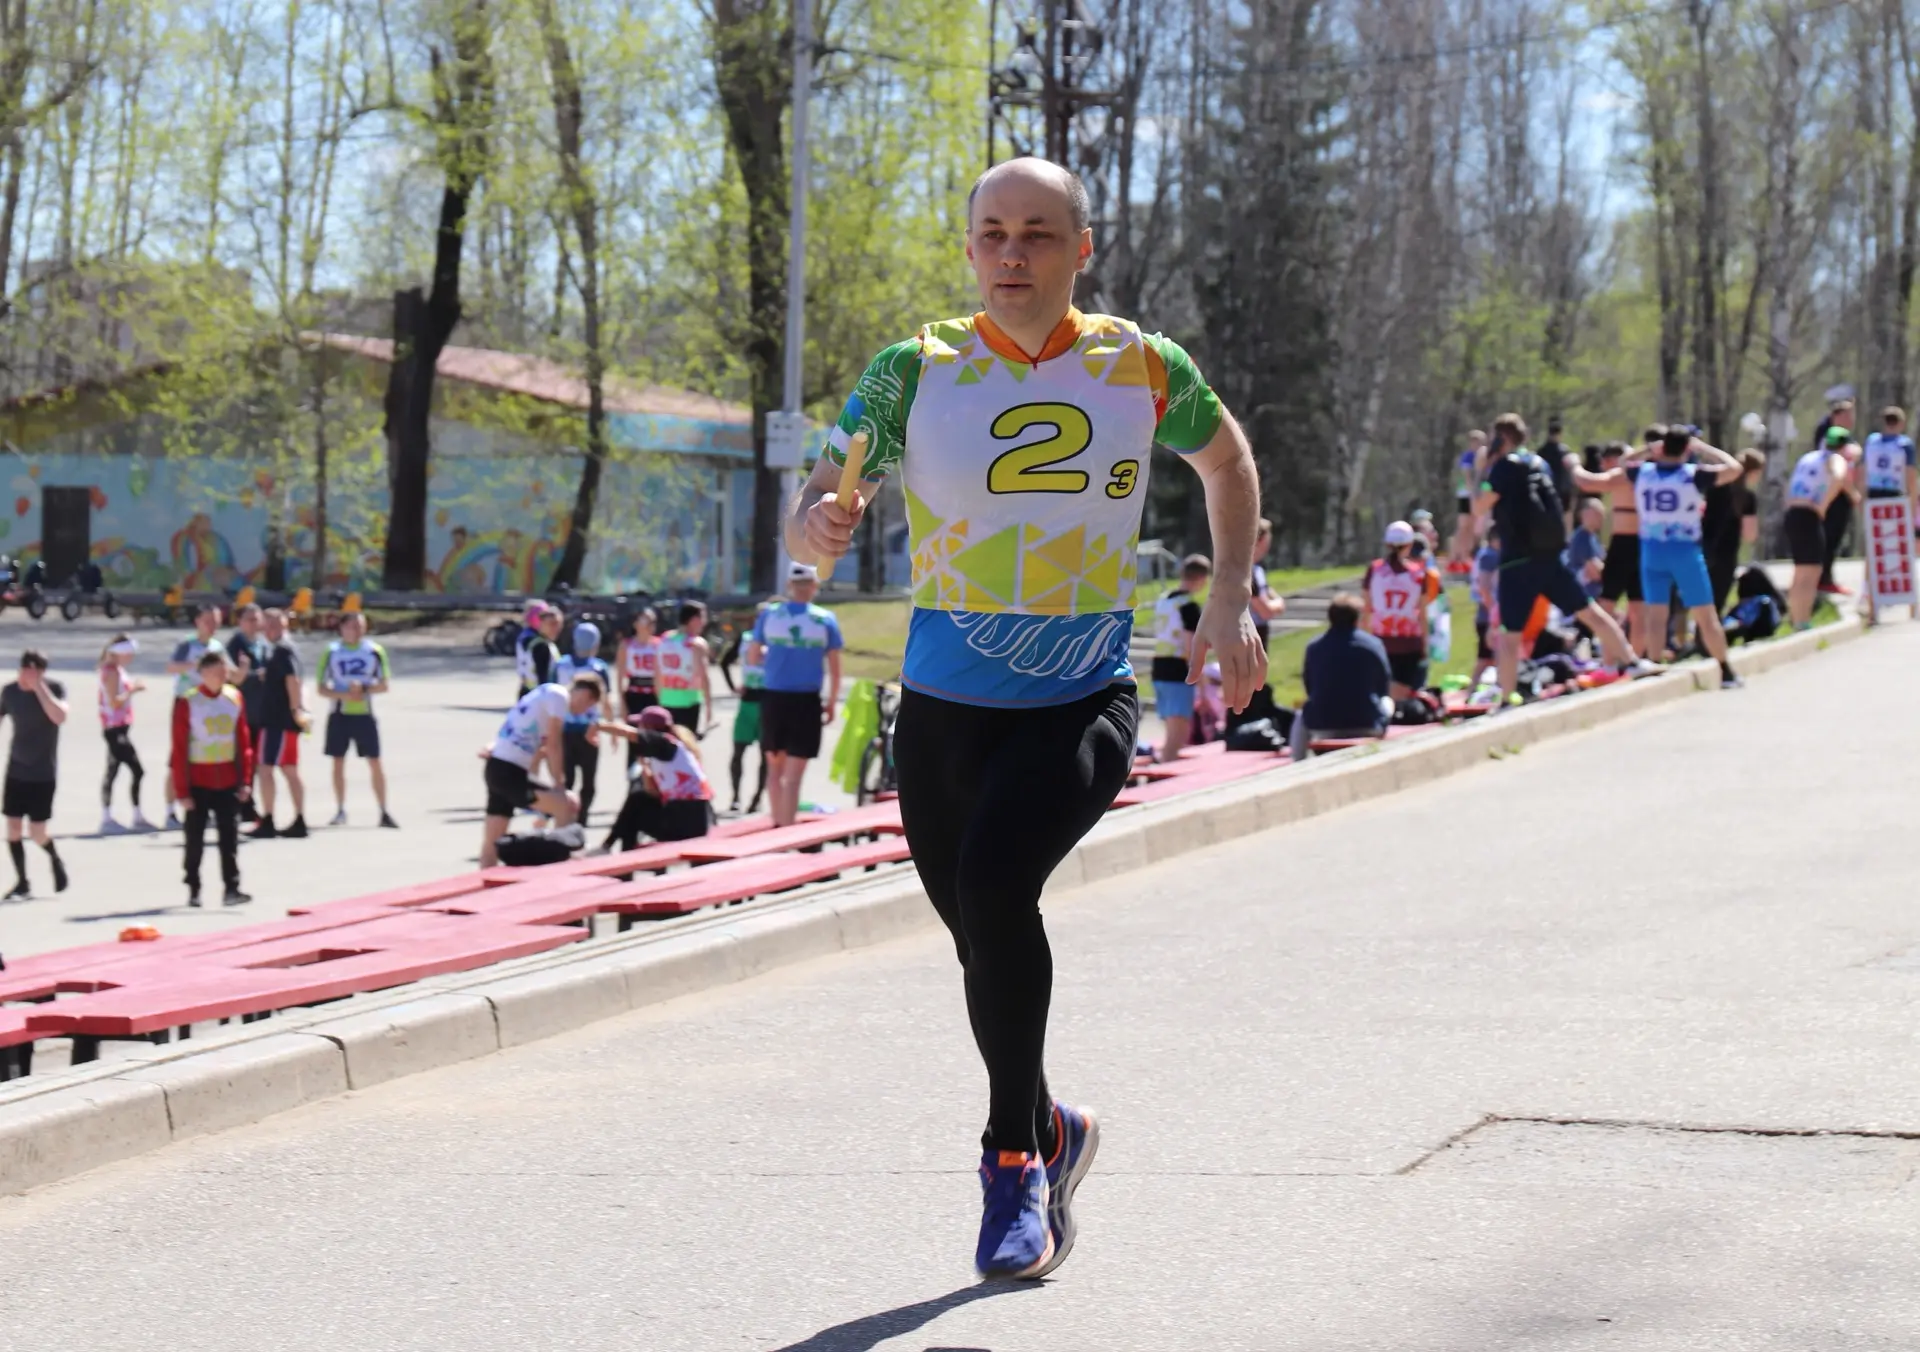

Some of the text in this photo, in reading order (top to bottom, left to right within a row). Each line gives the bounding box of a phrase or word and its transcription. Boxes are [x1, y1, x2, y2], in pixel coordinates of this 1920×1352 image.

[987, 402, 1139, 499] 2 3
[1642, 488, 1679, 512] 19
[1384, 589, 1410, 610] 17
[337, 658, 367, 676] 12
